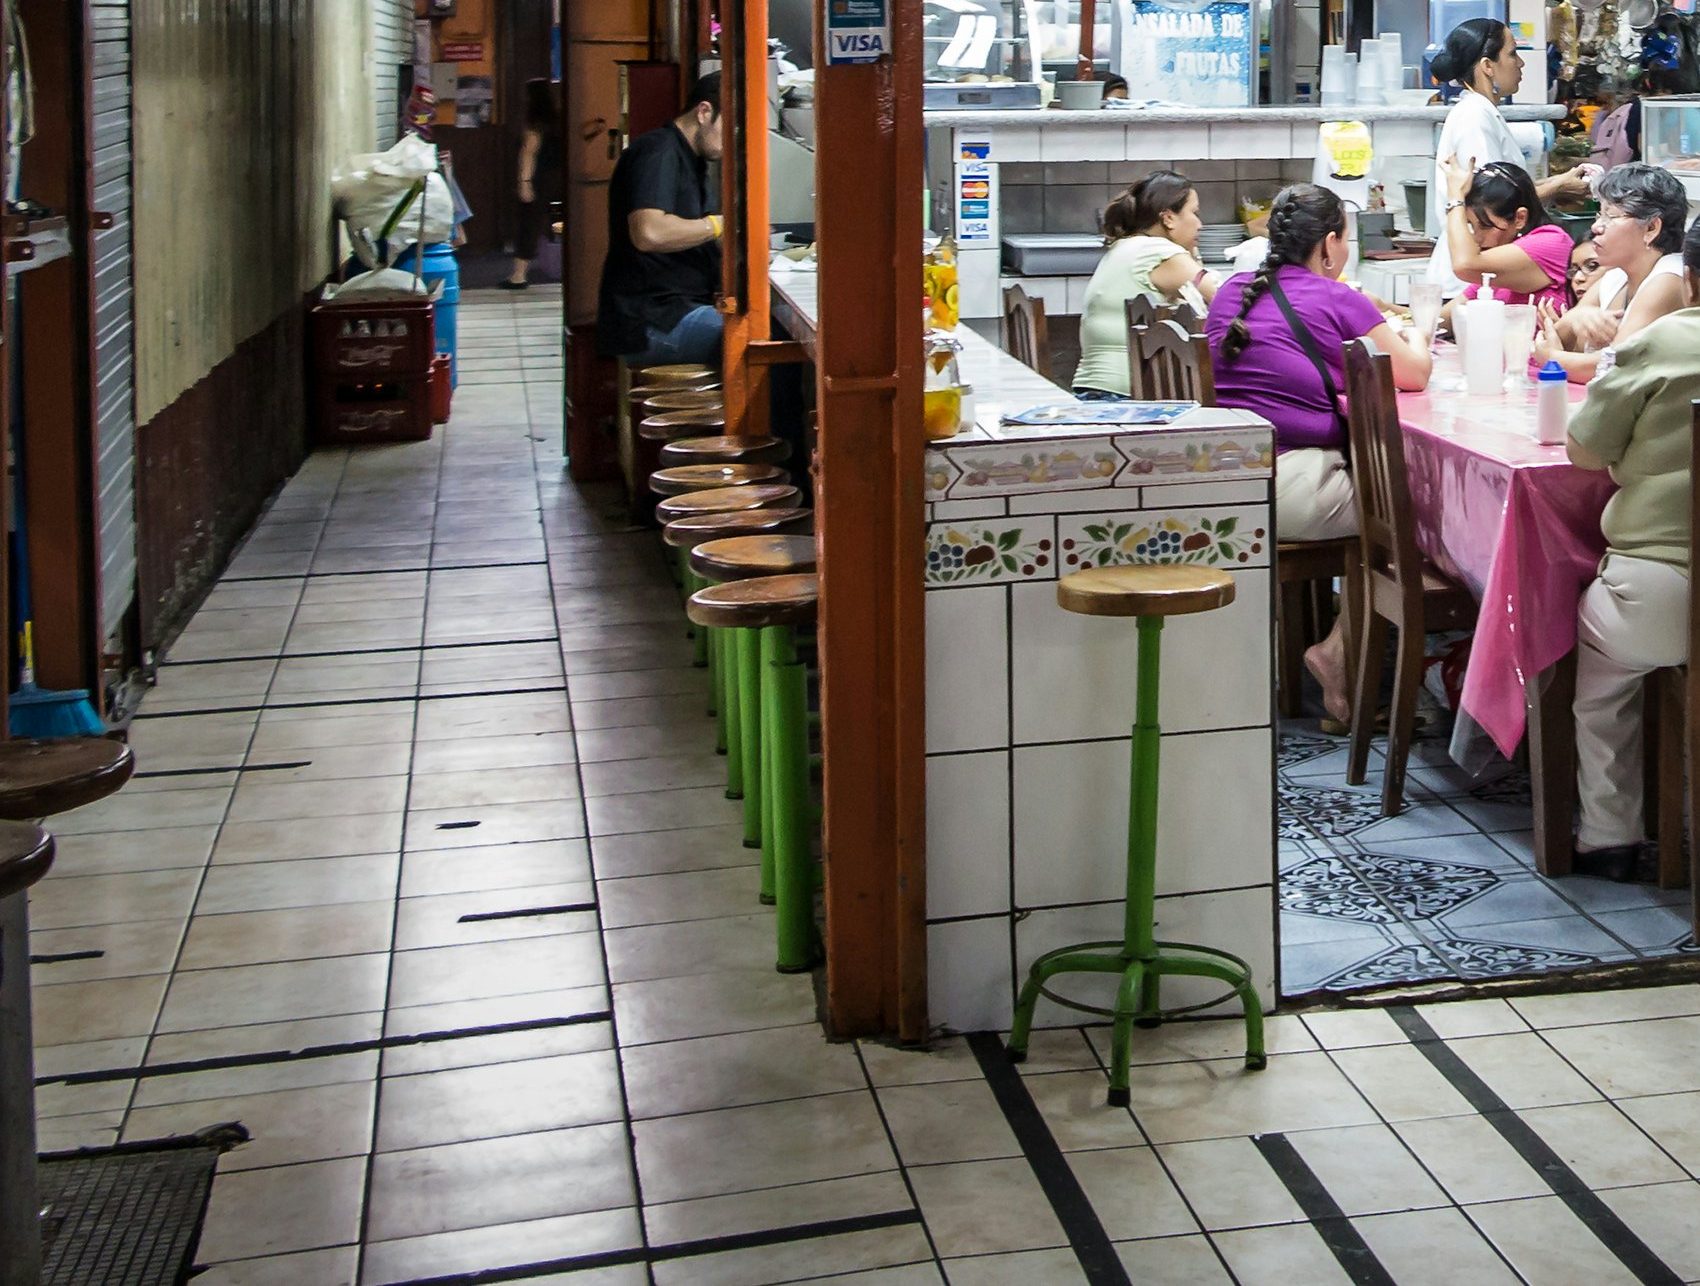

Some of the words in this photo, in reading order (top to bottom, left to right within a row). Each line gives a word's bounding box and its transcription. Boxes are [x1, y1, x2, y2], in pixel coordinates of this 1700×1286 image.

[1220, 13, 1243, 37] DE
[834, 33, 885, 53] VISA
[1175, 51, 1241, 76] FRUTAS
